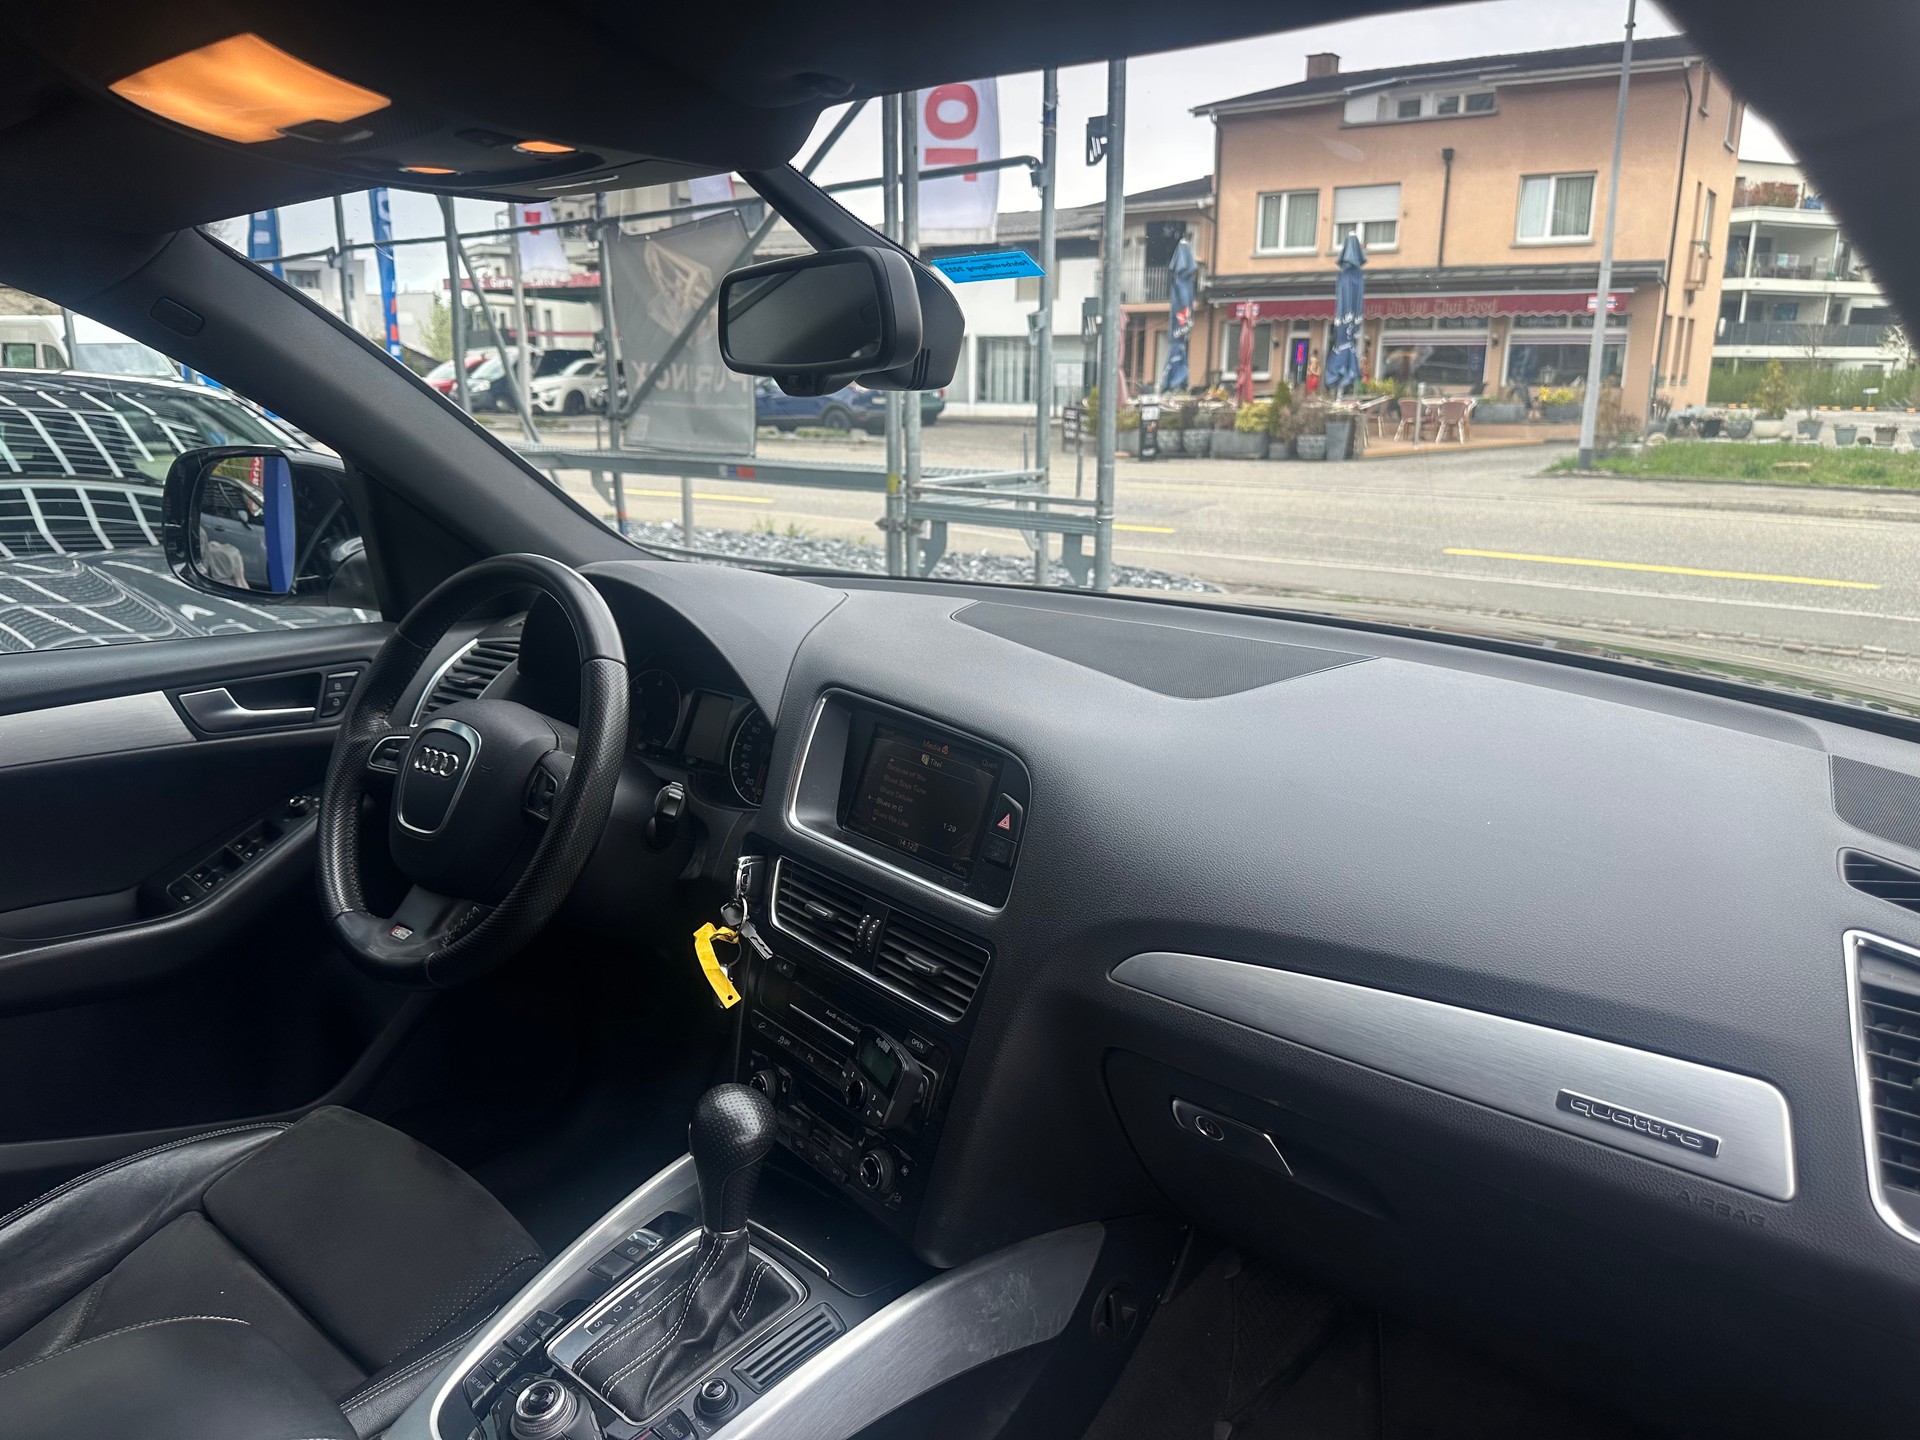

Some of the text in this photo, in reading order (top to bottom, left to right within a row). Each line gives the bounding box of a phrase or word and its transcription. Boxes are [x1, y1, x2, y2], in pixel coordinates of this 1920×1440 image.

[1466, 298, 1497, 314] Food
[922, 740, 941, 752] Media
[930, 758, 943, 768] Titel
[876, 797, 891, 808] Blues
[943, 822, 957, 833] 1:29
[899, 838, 914, 850] 14:12
[911, 1037, 925, 1050] OPEN
[1570, 1097, 1703, 1149] quattro
[1675, 1190, 1767, 1227] AIRBAG
[650, 1277, 659, 1285] R
[632, 1291, 641, 1299] N
[612, 1305, 622, 1313] D
[536, 1318, 546, 1328] NAV
[594, 1320, 603, 1328] S
[515, 1334, 528, 1346] INFO
[492, 1358, 503, 1369] CAR
[470, 1377, 486, 1390] SETUP
[666, 1423, 684, 1439] RADIO
